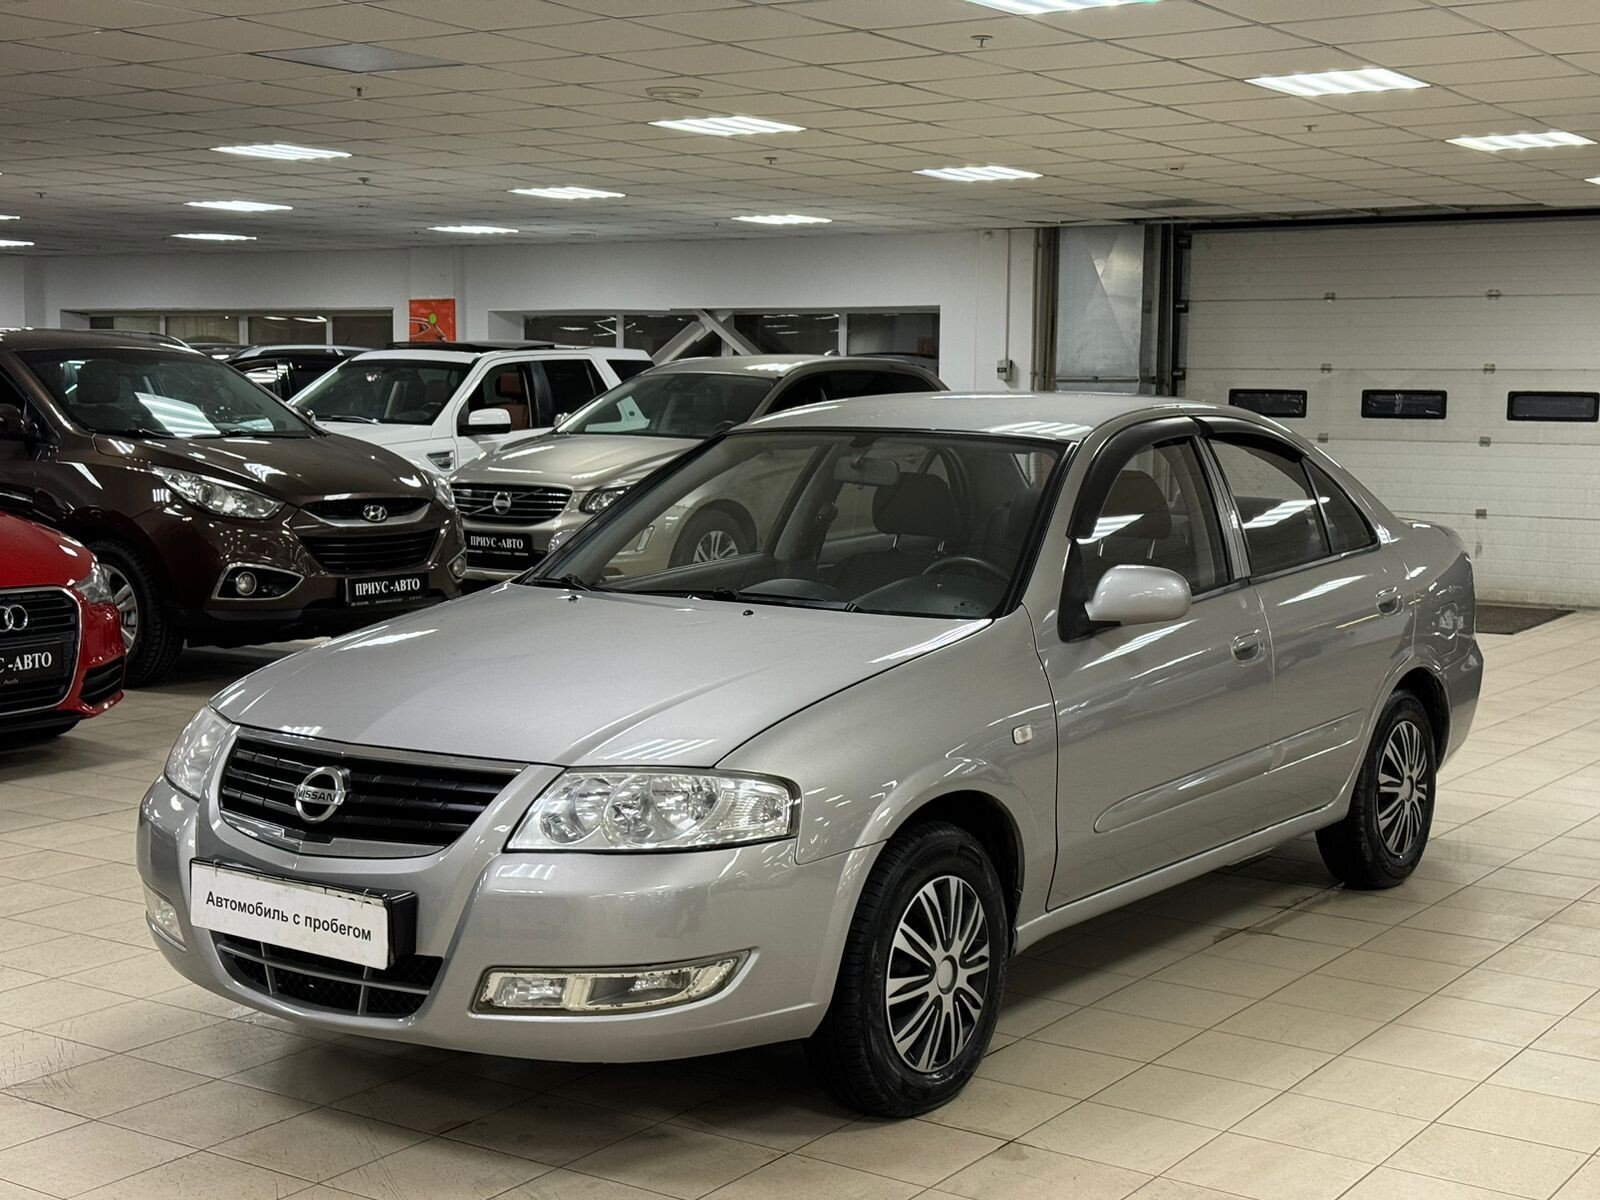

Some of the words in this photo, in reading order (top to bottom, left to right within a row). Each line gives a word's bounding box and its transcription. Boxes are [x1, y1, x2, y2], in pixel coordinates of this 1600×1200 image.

[296, 787, 337, 802] NISSAN
[205, 890, 289, 923] Автомобиль
[292, 912, 301, 925] с
[304, 914, 372, 942] пробегом
